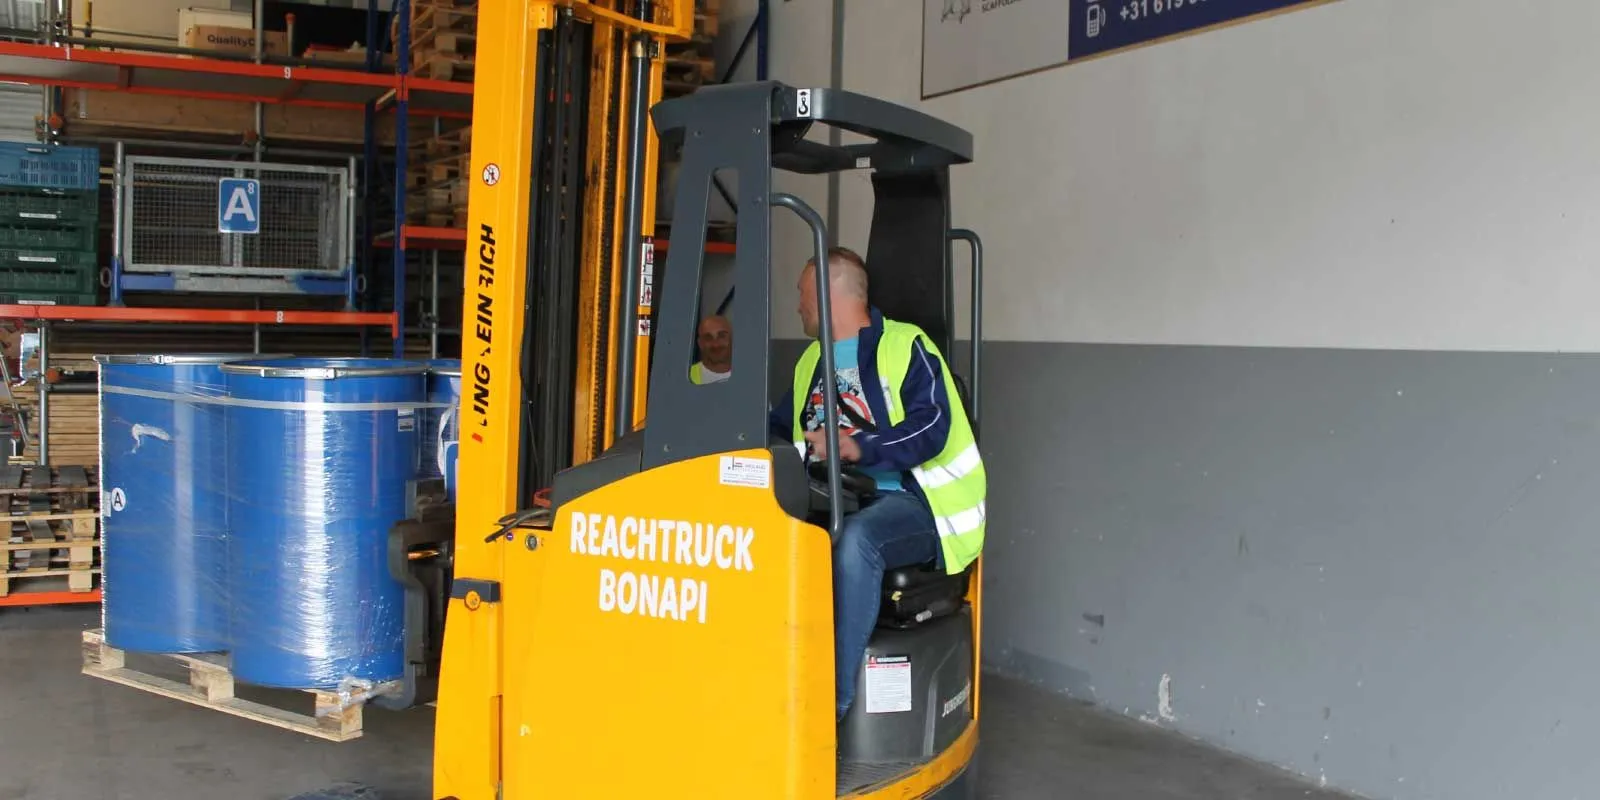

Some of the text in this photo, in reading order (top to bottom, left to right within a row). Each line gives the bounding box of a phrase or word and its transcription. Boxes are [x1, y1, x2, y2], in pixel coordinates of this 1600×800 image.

[284, 66, 291, 79] 9
[223, 187, 256, 221] A
[114, 491, 123, 507] A
[570, 511, 755, 572] REACHTRUCK
[599, 568, 708, 624] BONAPI
